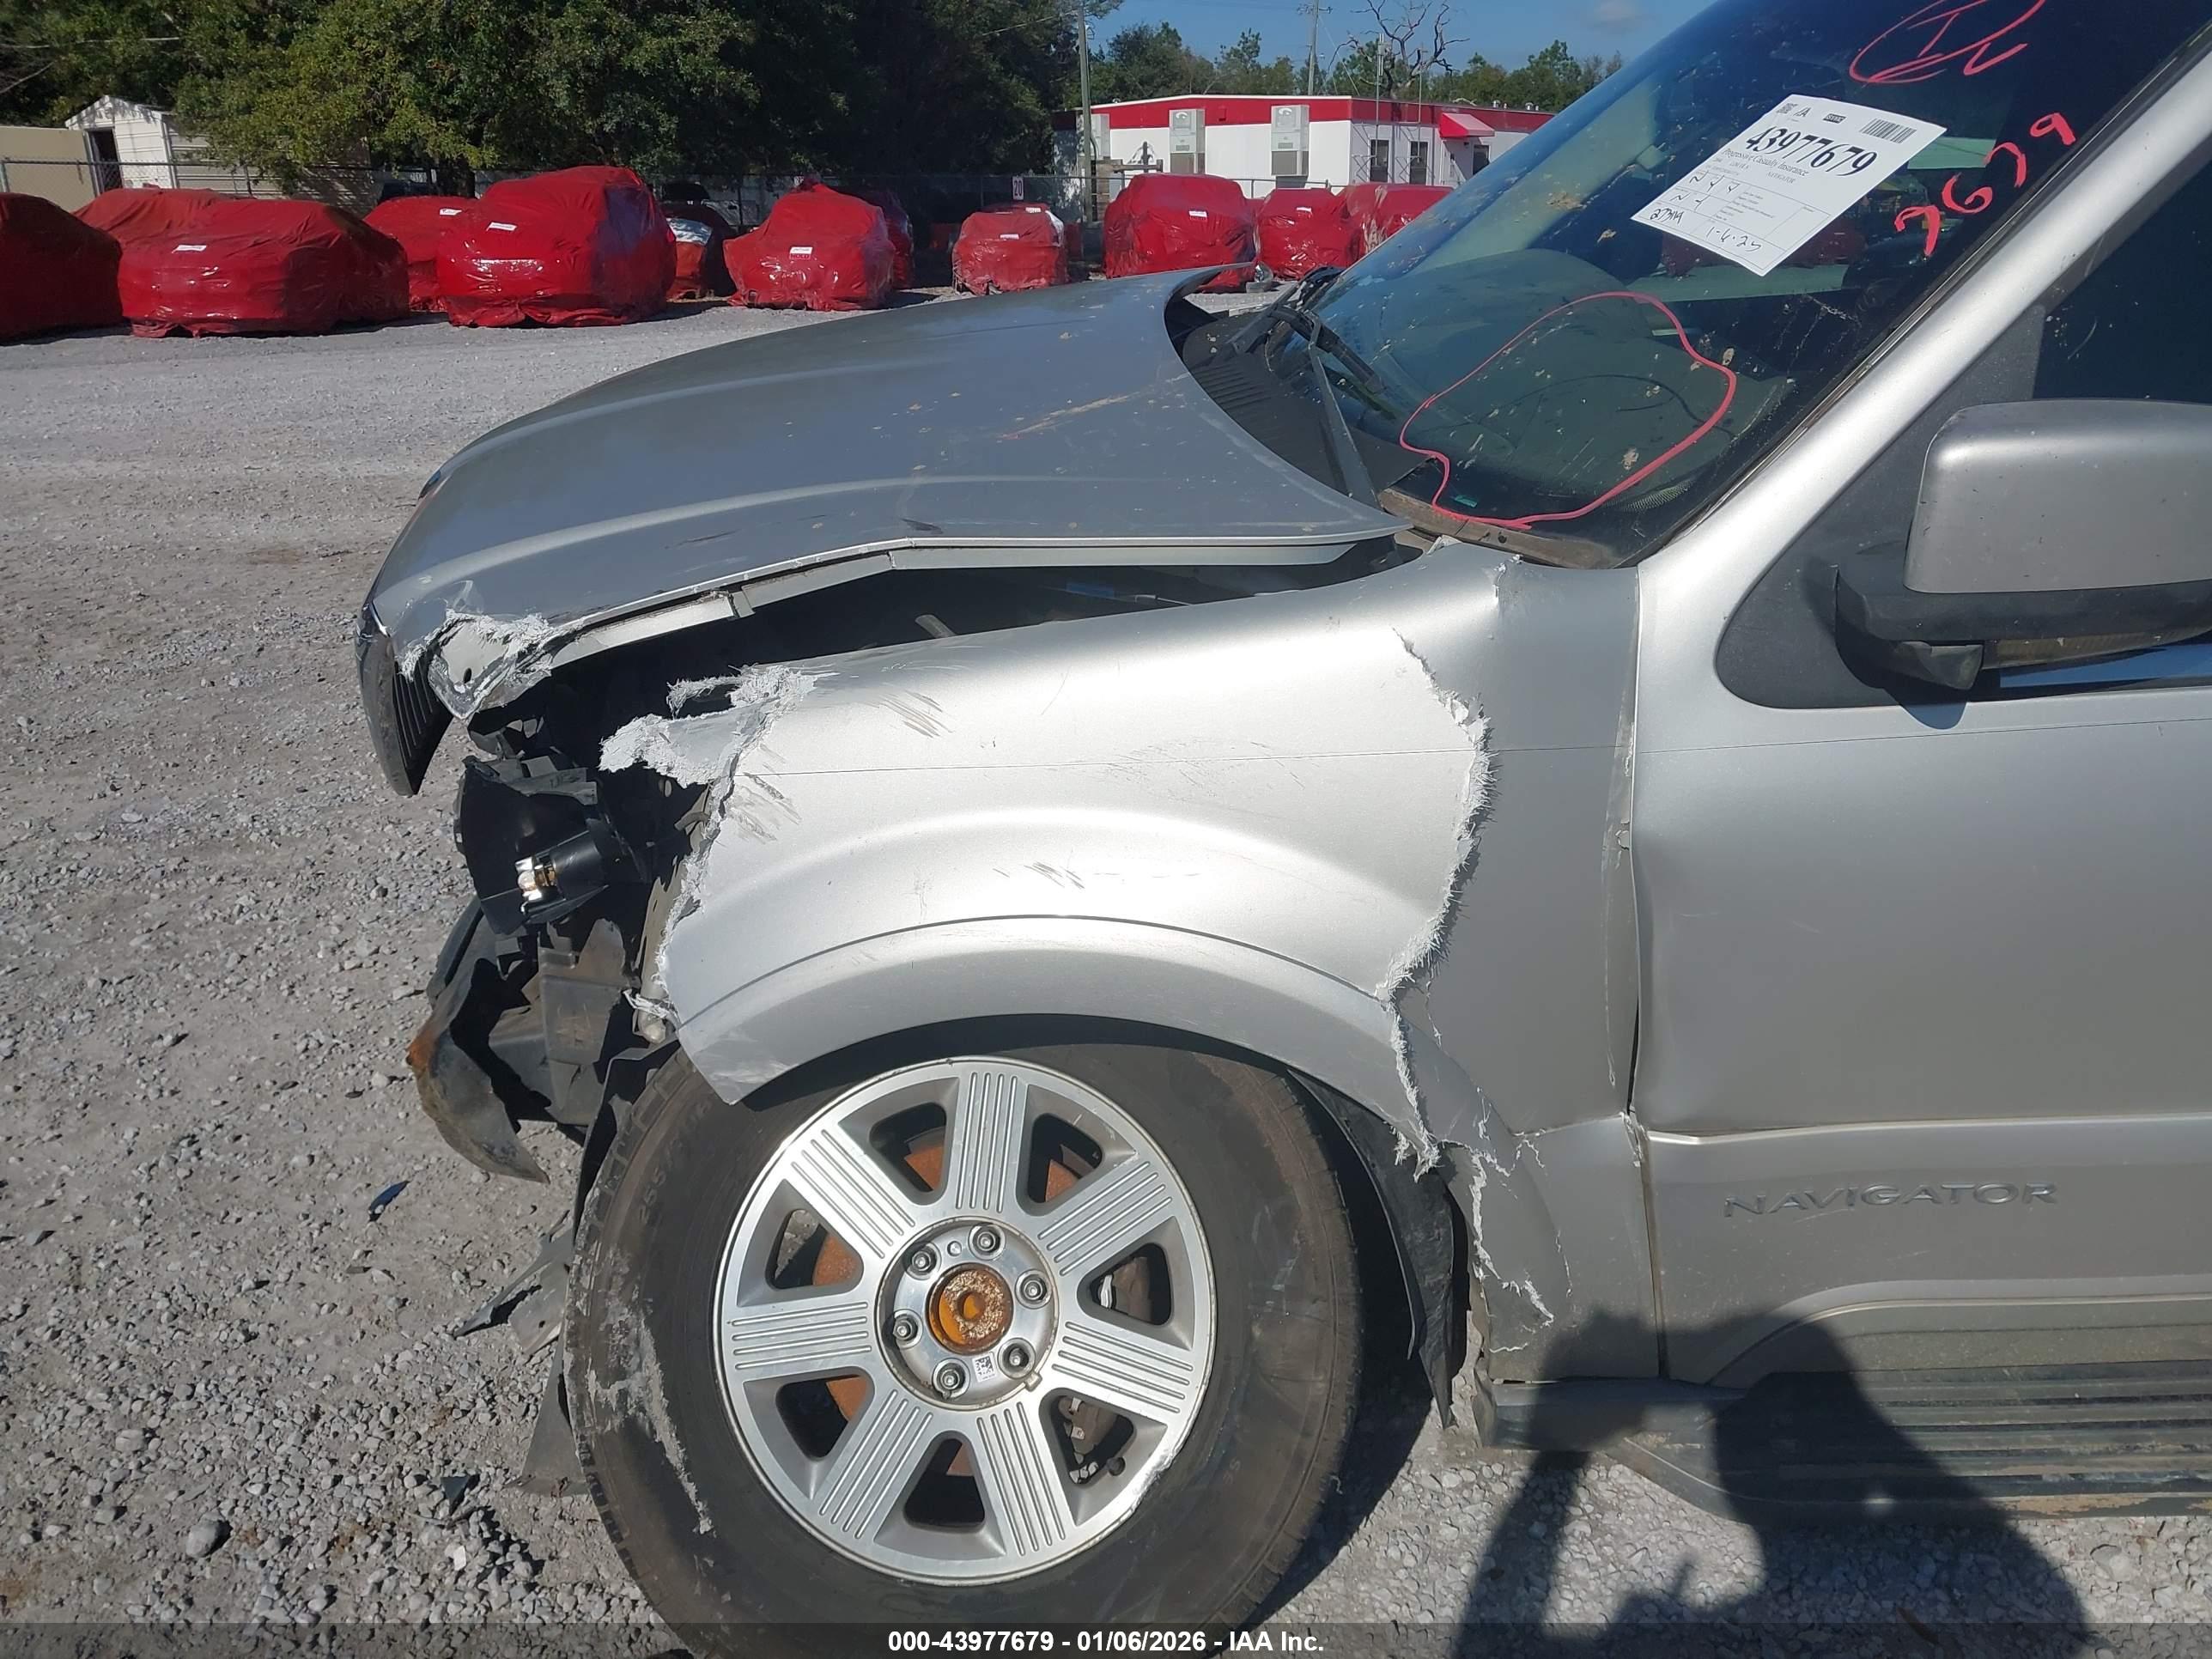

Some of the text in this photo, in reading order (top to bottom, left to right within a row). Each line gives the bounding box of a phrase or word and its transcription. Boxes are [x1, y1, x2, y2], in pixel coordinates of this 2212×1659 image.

[1745, 125, 1878, 177] 43977679
[1778, 161, 1809, 176] Insurance
[1723, 1182, 2058, 1218] NAVIGATOR
